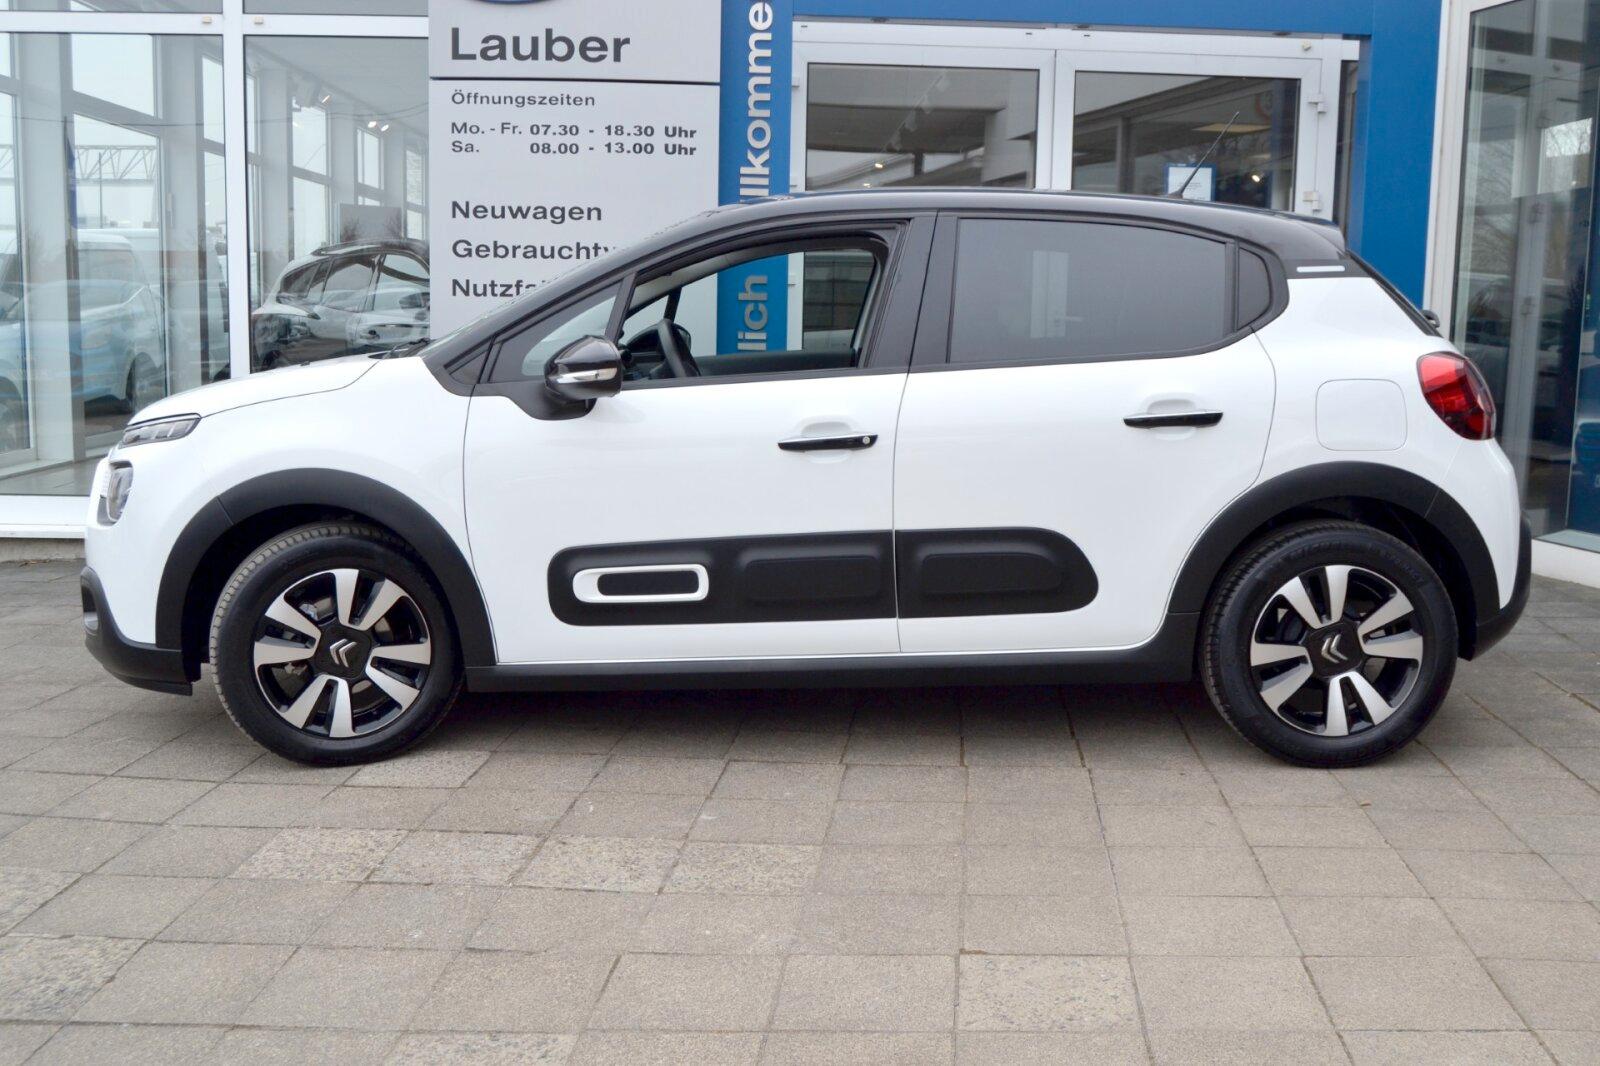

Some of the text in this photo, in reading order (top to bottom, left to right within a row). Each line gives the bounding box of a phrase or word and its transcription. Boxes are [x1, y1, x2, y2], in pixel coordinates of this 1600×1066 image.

[451, 27, 631, 63] Lauber
[451, 89, 595, 108] Öffnungszeiten
[739, 2, 774, 203] llkomme
[451, 122, 485, 135] Mo.
[500, 122, 522, 135] Fr.
[529, 123, 580, 137] 07.30
[604, 124, 655, 138] 18.30
[664, 125, 698, 139] Uhr
[451, 140, 480, 153] Sa.
[529, 142, 580, 155] 08.00
[604, 142, 655, 155] 13.00
[664, 143, 697, 156] Uhr
[451, 200, 603, 225] Neuwagen
[451, 239, 618, 260] Gebraucht
[451, 278, 546, 298] Nutzf
